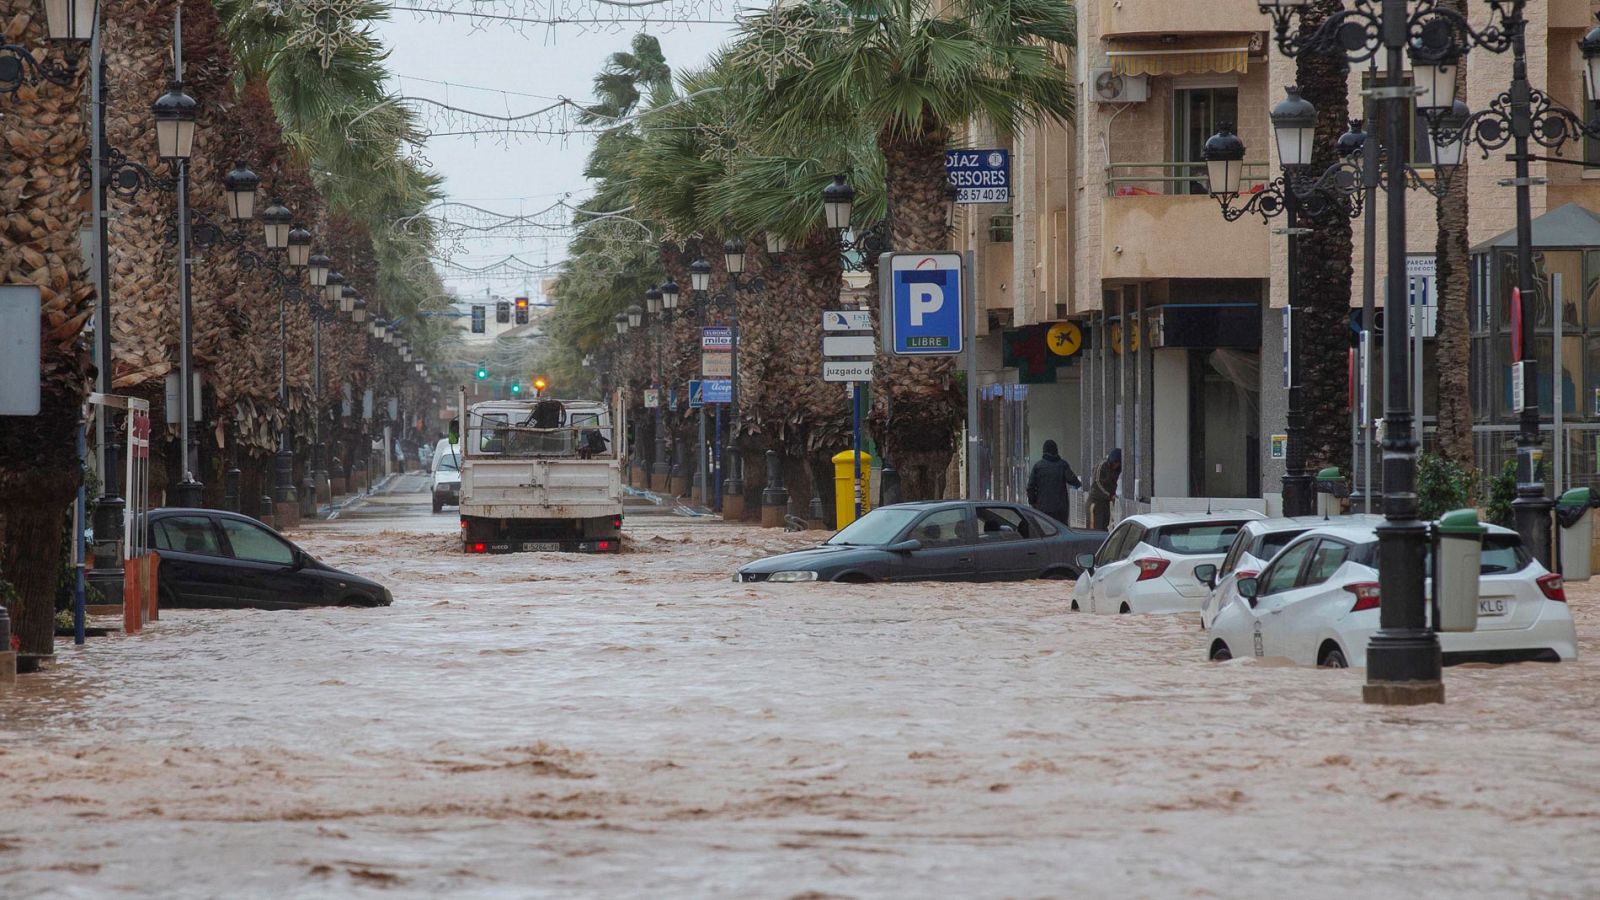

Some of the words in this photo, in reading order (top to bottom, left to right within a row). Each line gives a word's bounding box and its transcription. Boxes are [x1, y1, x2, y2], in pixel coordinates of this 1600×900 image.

[947, 170, 1006, 186] SESORES
[971, 189, 981, 200] 57
[983, 189, 993, 200] 40
[996, 189, 1007, 200] 29
[909, 282, 944, 326] P
[911, 337, 942, 346] LIBRE
[826, 368, 862, 376] juzgado
[1480, 600, 1504, 612] KLG
